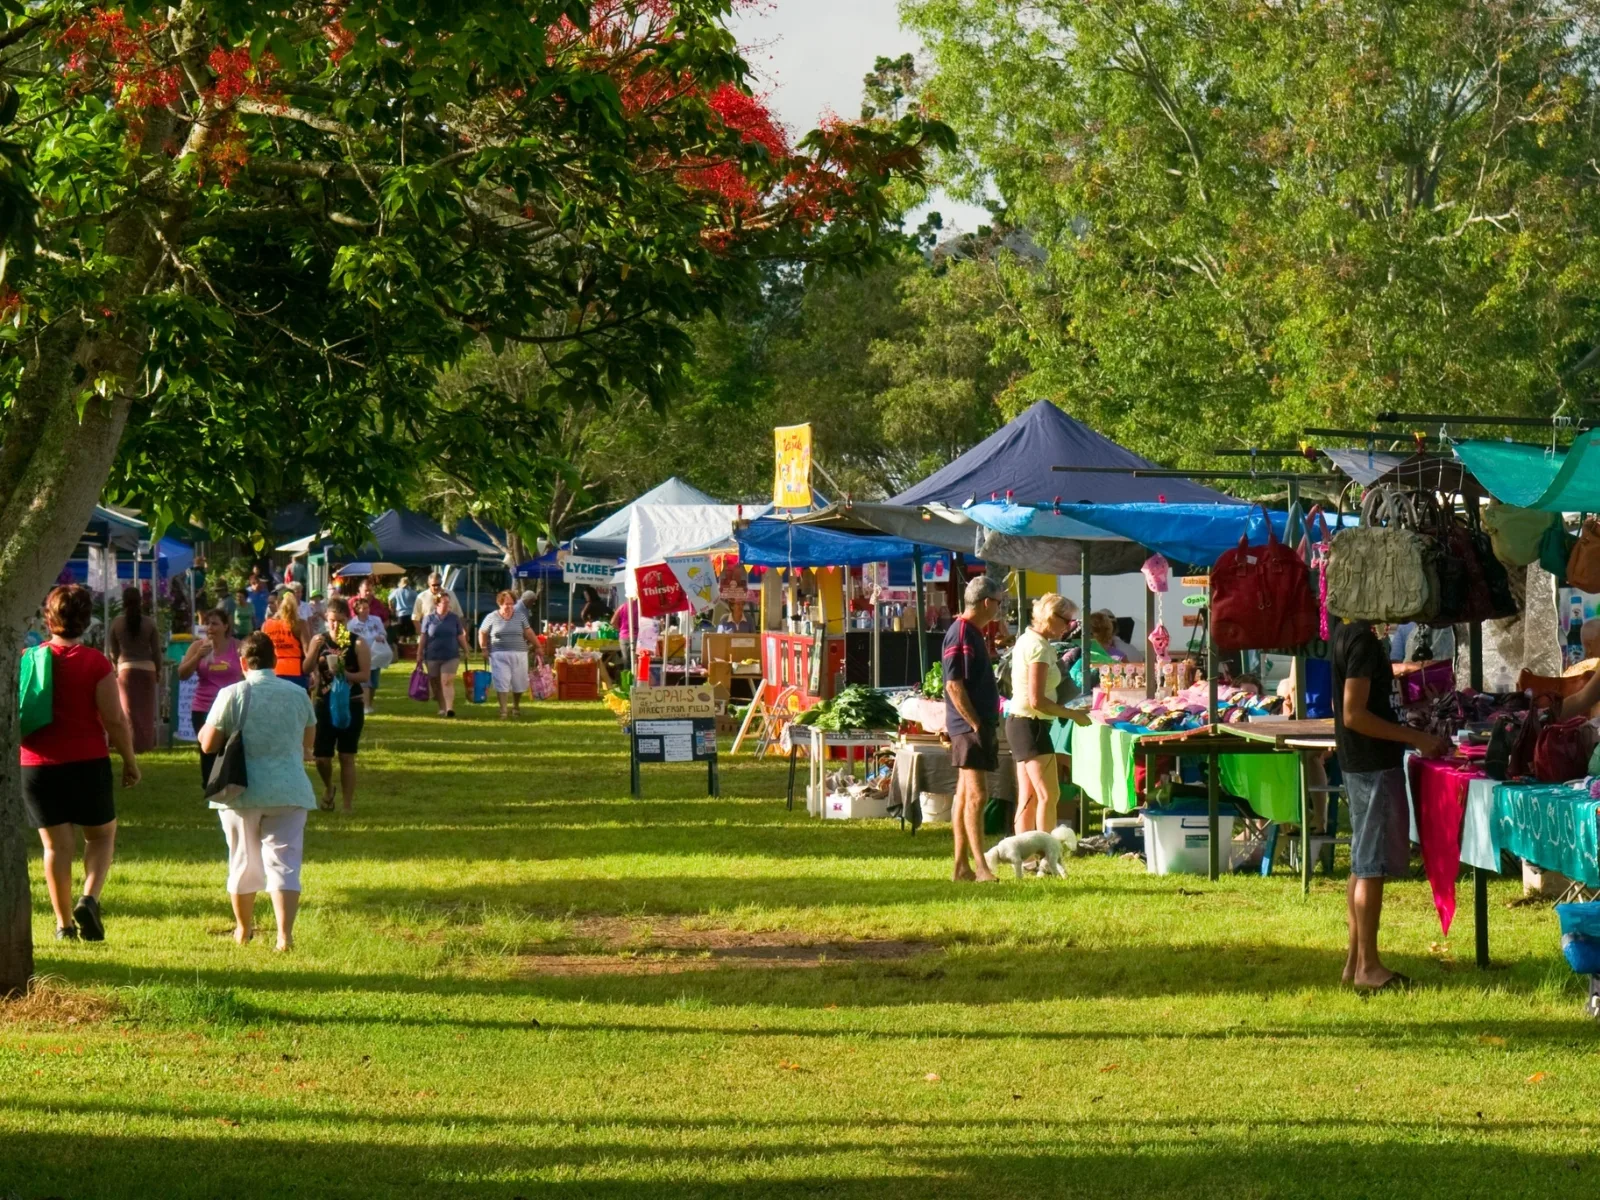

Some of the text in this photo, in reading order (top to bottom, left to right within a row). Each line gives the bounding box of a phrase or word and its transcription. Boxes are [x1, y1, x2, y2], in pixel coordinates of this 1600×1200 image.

[643, 582, 680, 597] Thirsty?
[1186, 596, 1206, 604] Opals
[655, 688, 695, 703] OPALS
[638, 705, 710, 714] DIRECT FROM FIELD
